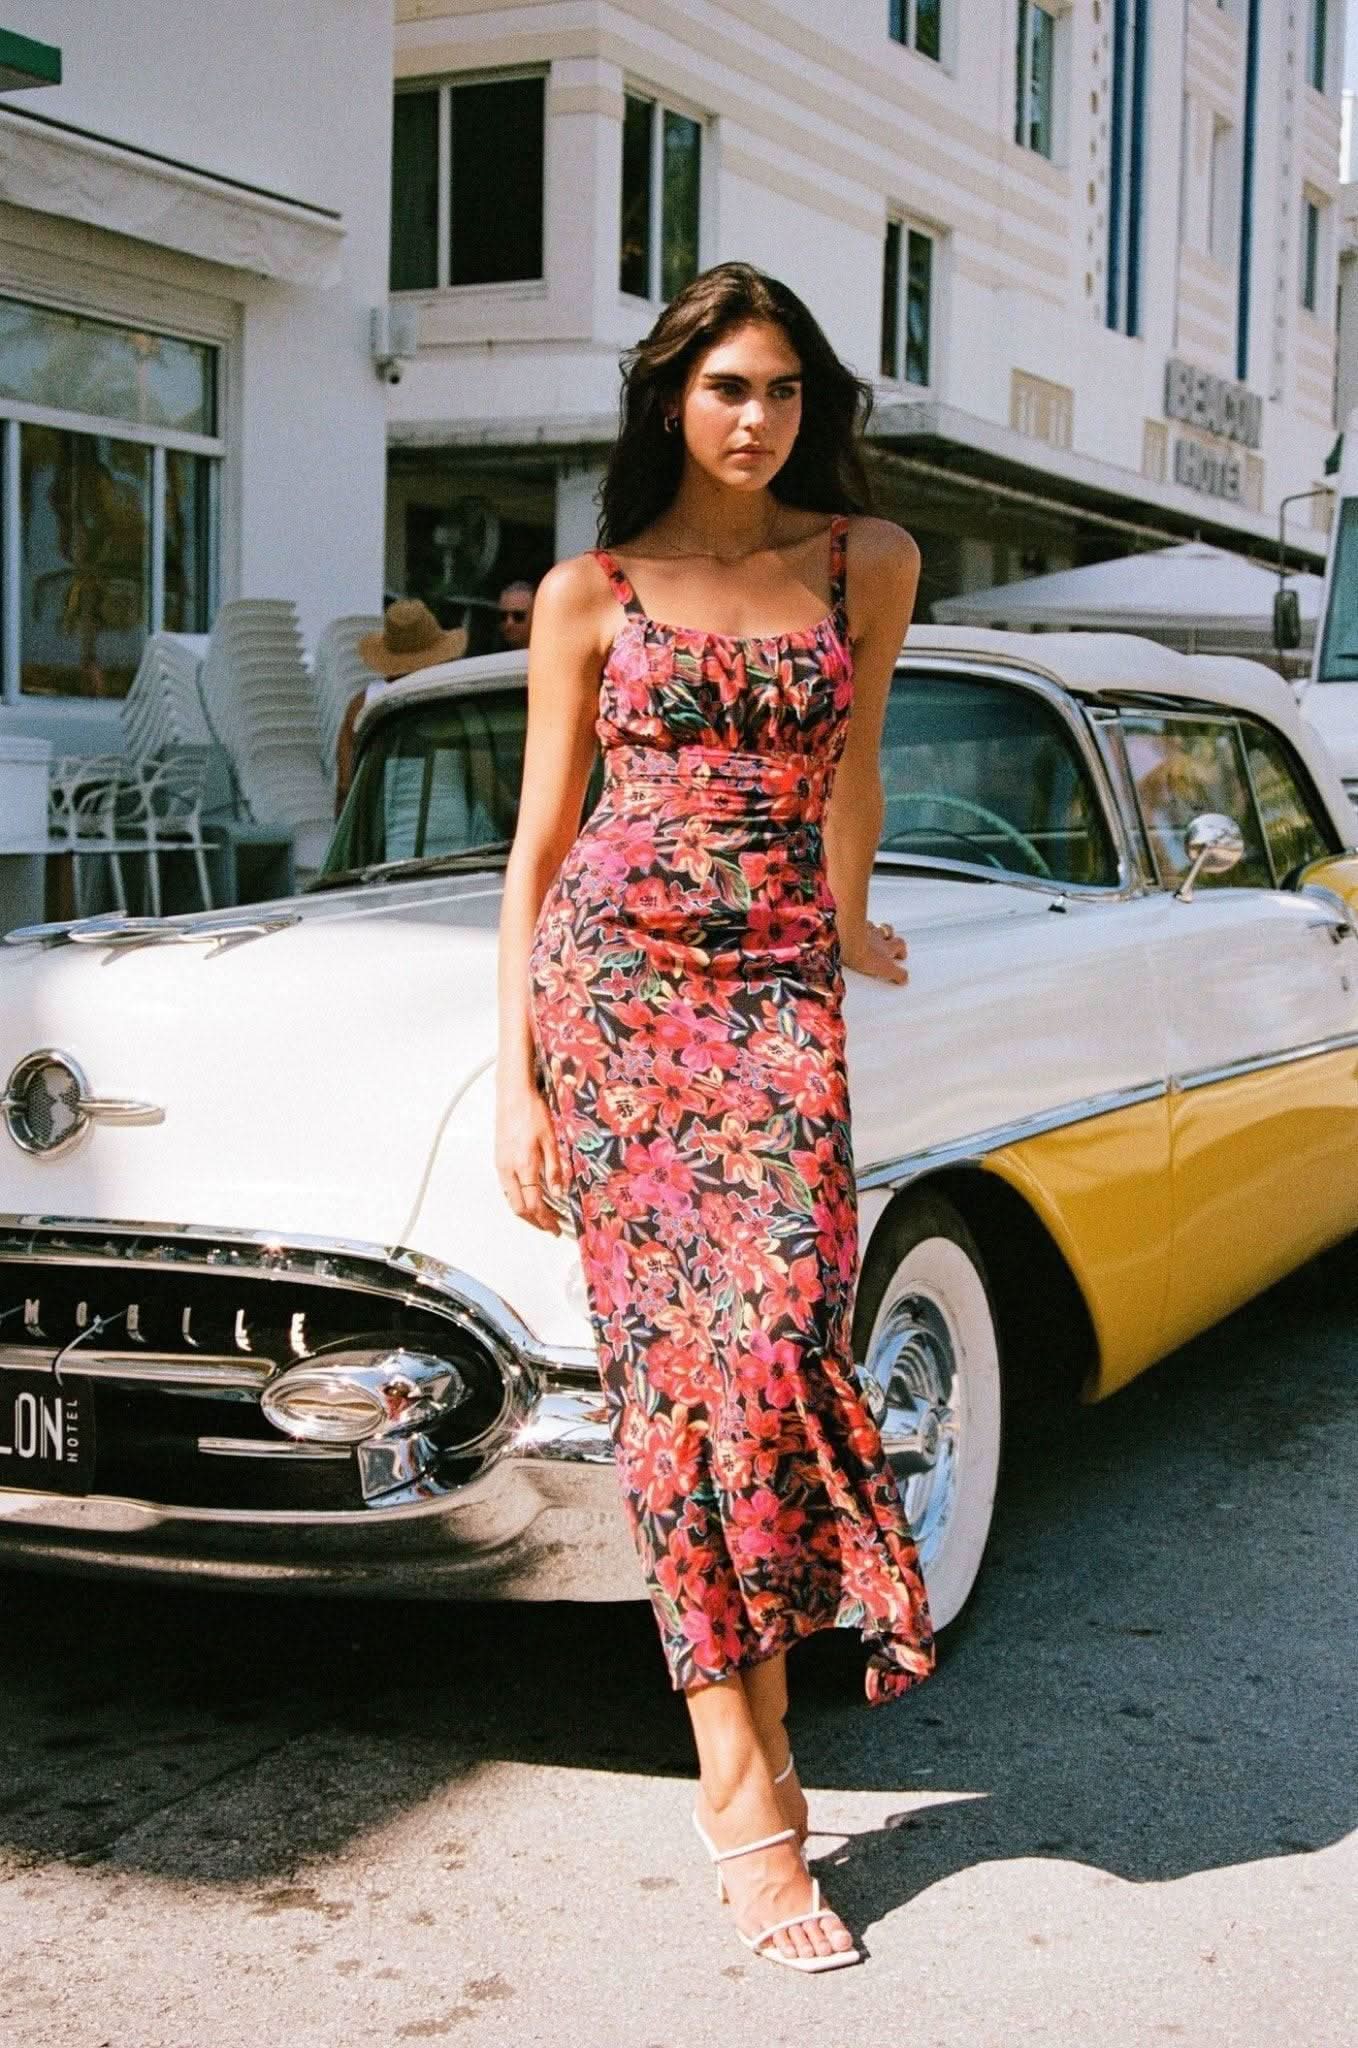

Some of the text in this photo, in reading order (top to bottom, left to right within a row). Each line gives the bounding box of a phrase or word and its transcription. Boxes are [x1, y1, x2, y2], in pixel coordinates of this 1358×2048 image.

[1165, 359, 1263, 449] BEACON
[1175, 439, 1244, 504] HOTEL
[66, 1399, 79, 1463] HOTEL
